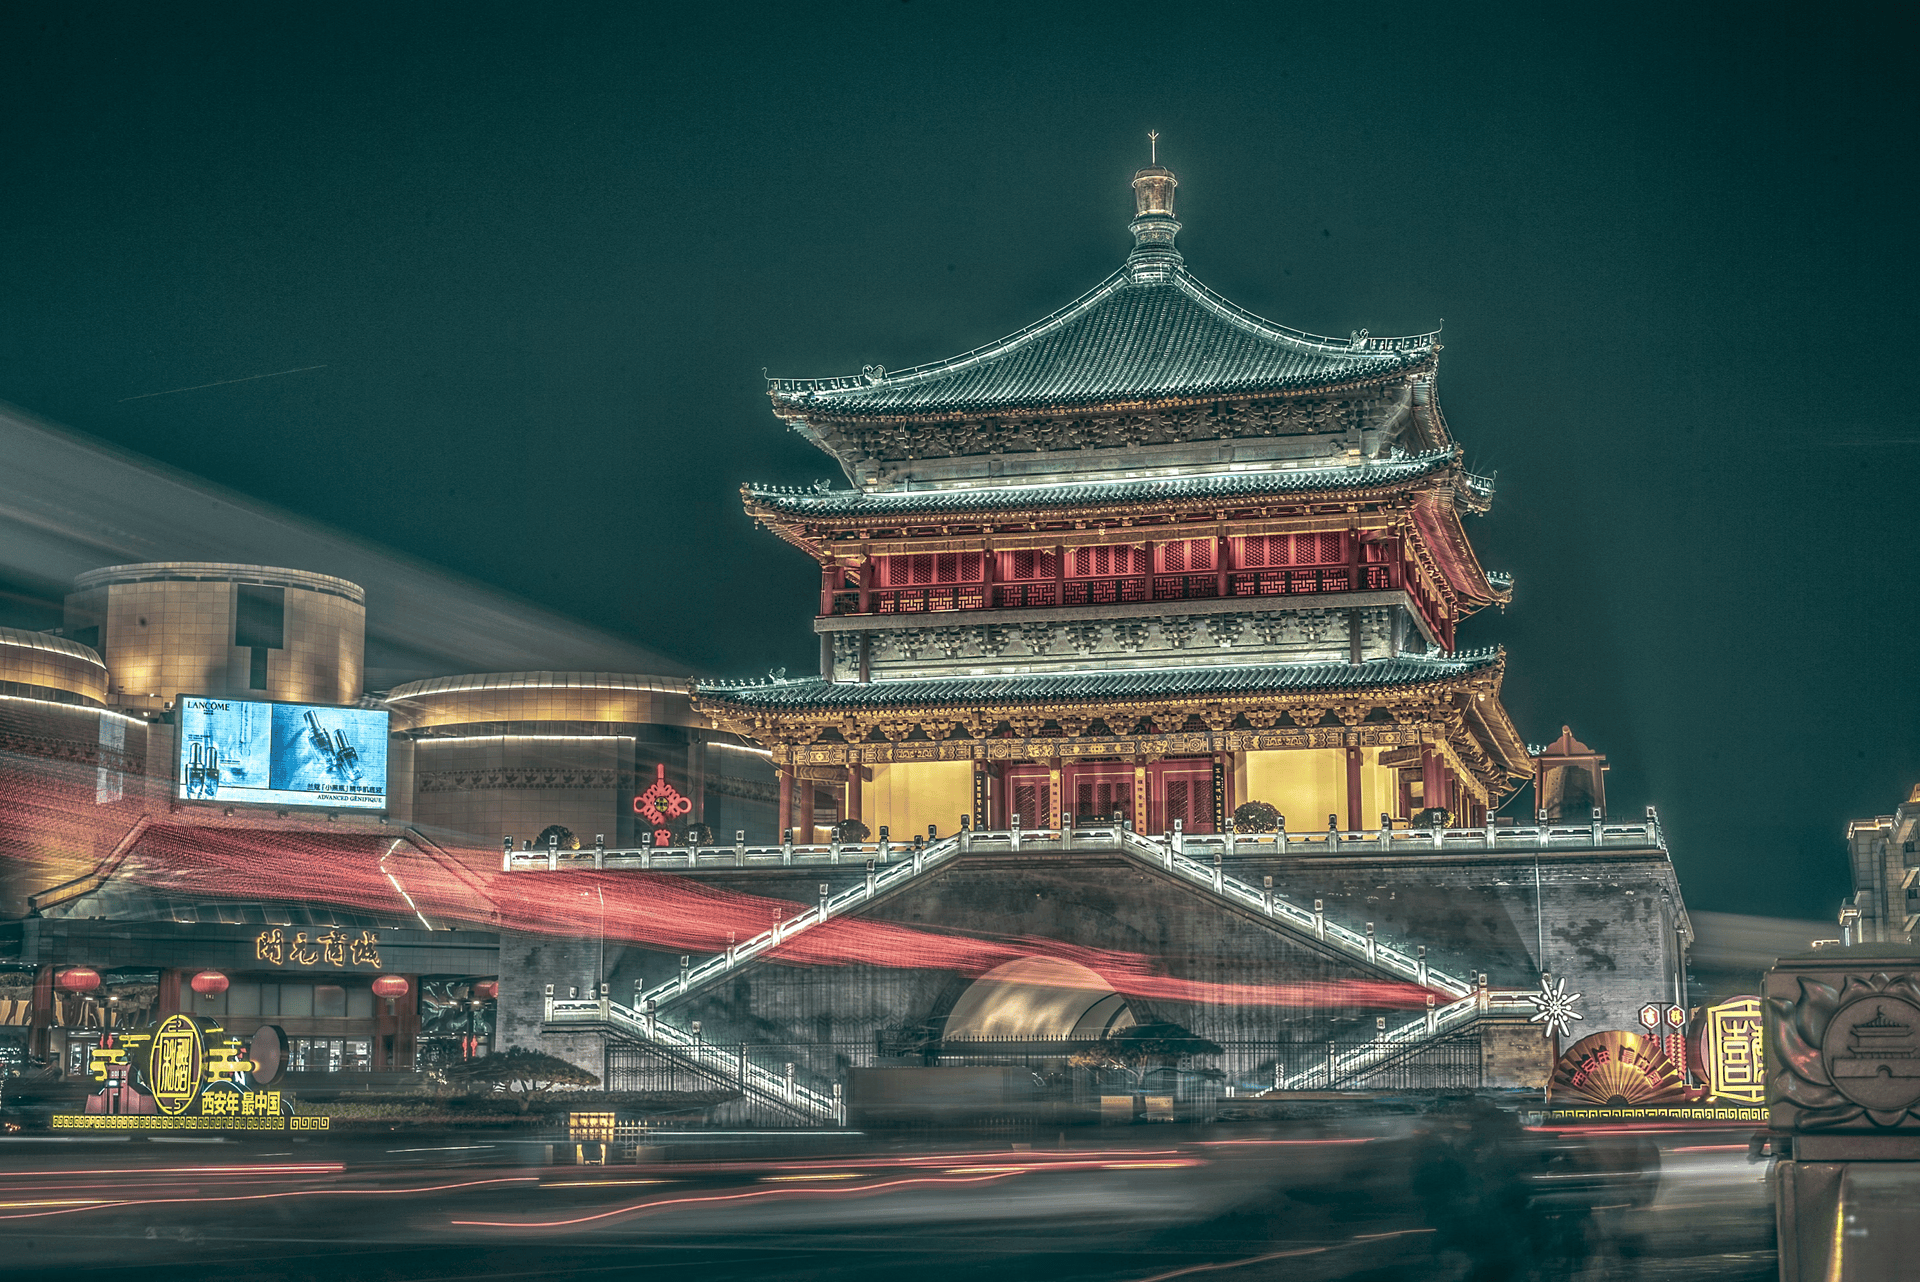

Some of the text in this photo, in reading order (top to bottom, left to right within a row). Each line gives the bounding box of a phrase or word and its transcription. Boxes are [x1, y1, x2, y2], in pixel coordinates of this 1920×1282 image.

[201, 1090, 281, 1116] 西安年 最中国
